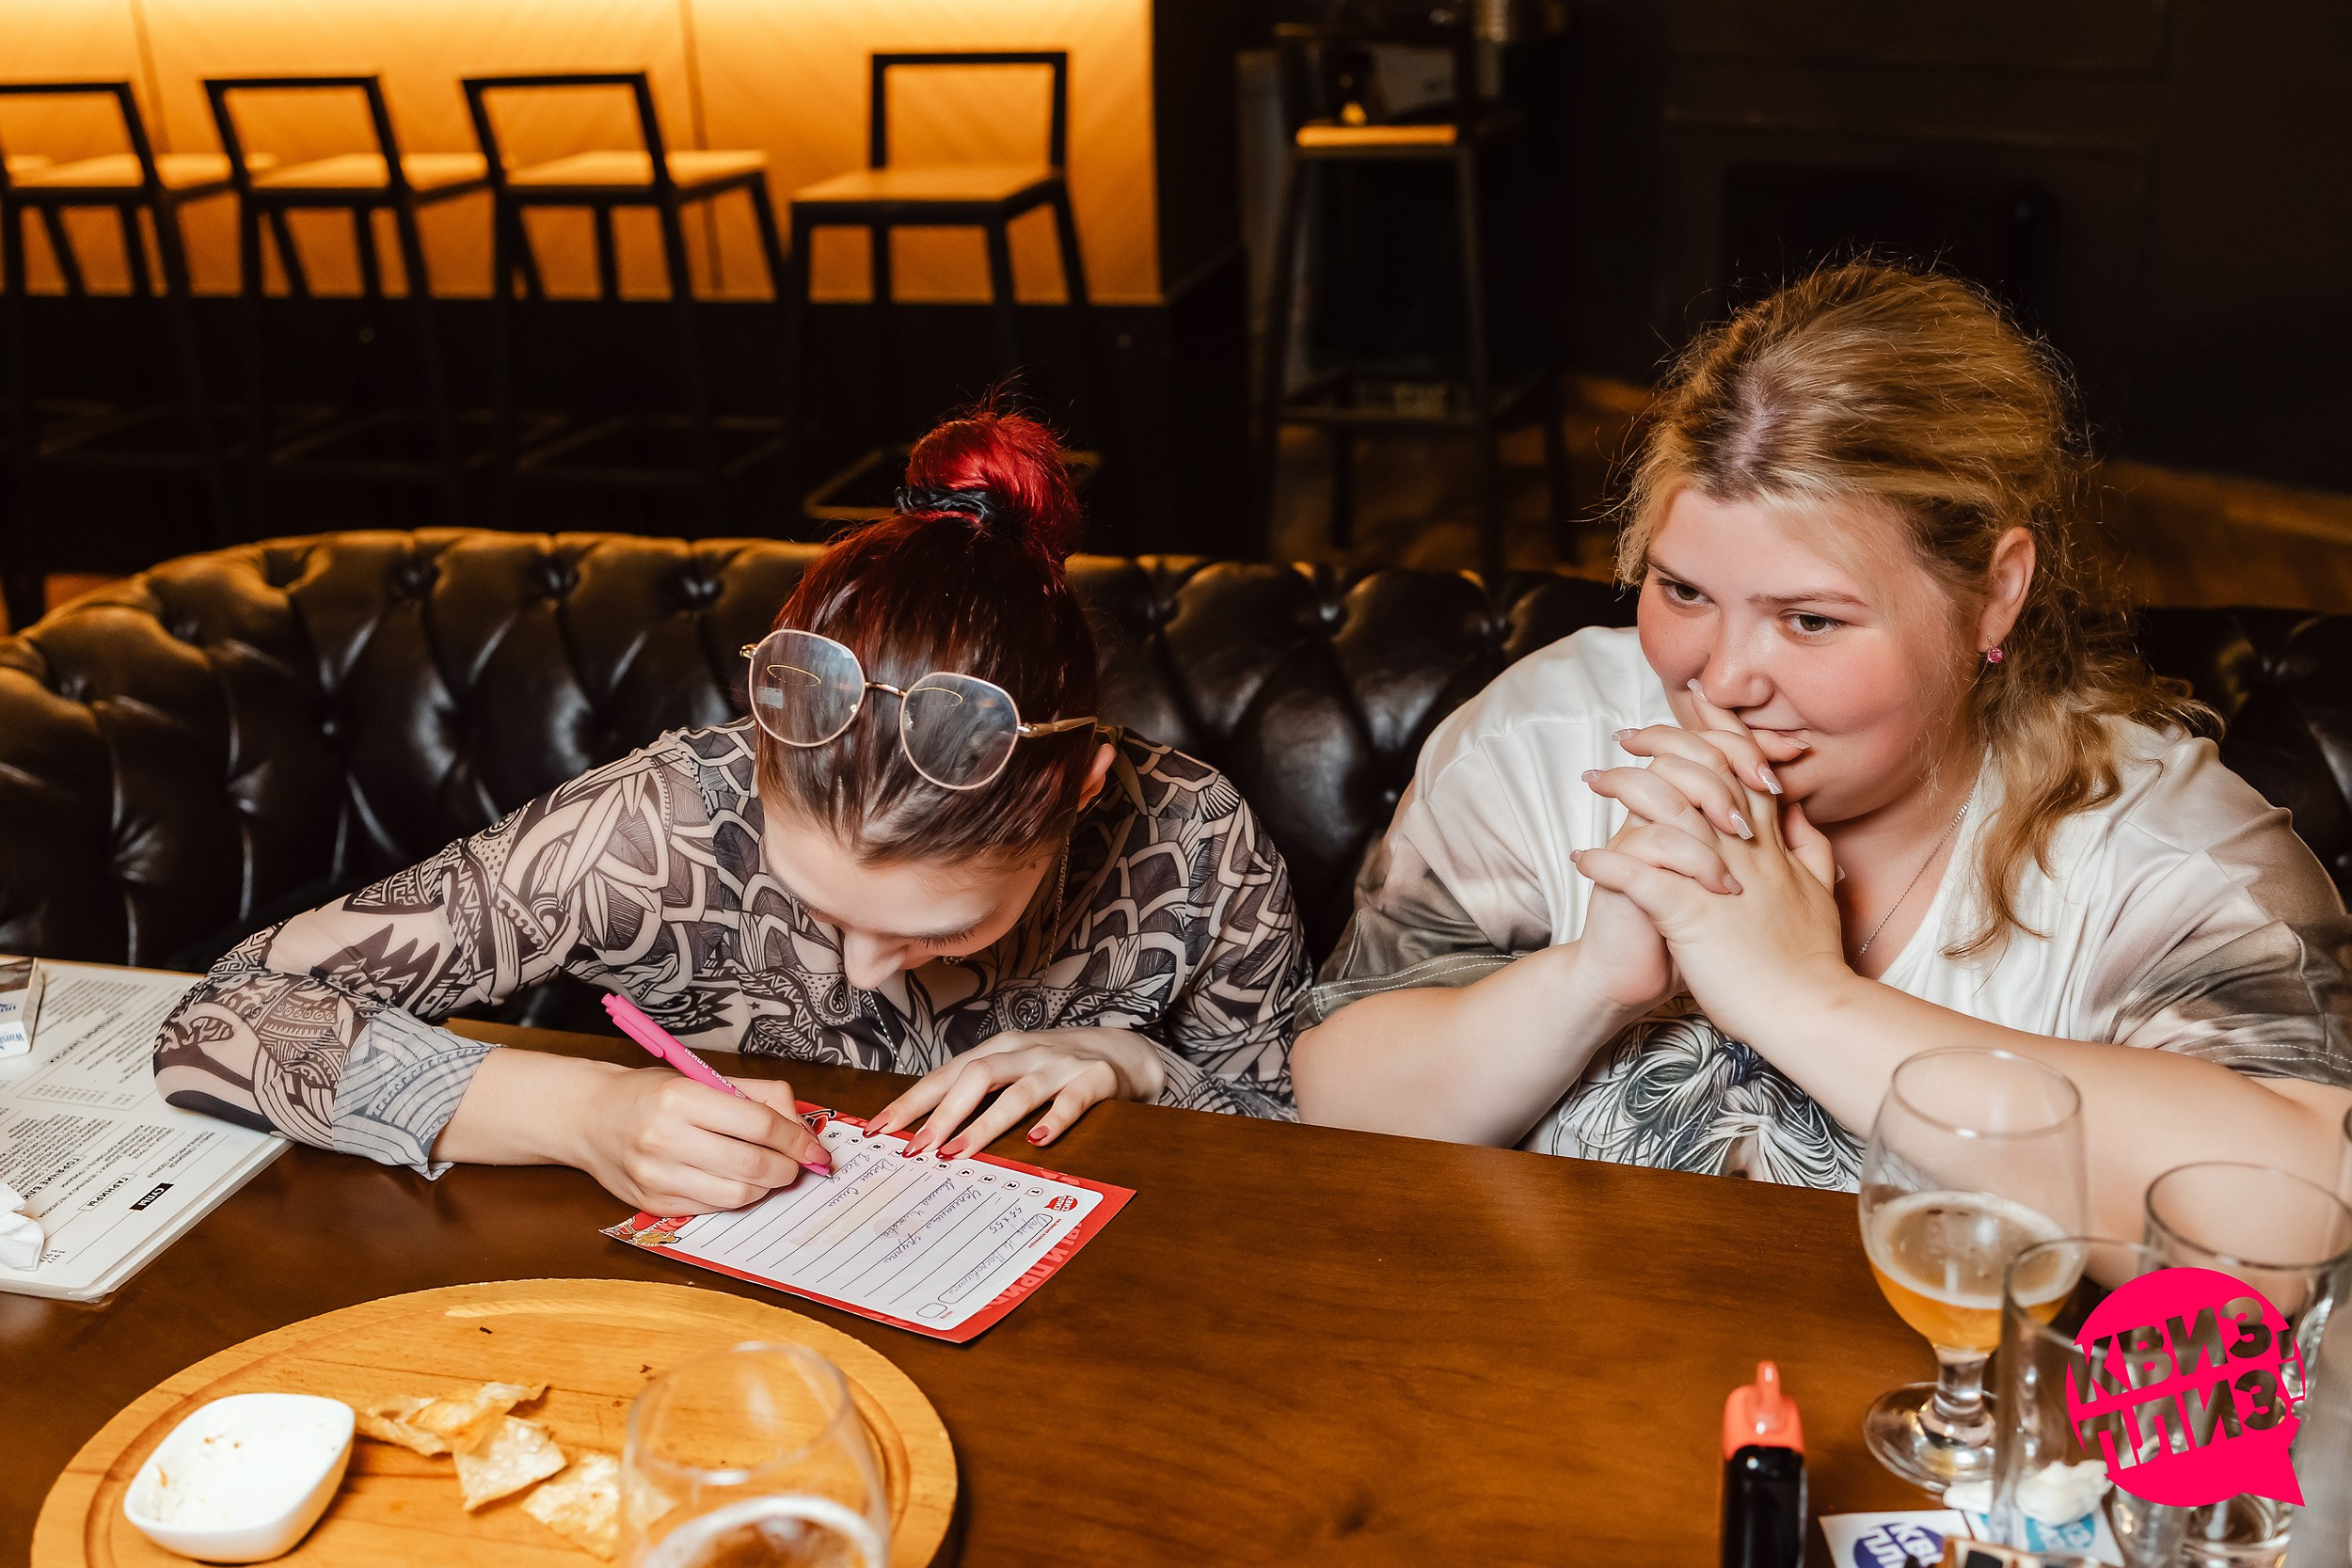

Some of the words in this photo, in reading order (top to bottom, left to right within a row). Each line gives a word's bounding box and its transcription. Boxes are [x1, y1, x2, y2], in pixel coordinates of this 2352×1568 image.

[42, 1157, 80, 1184] ГОРЯЧИЕ
[86, 1177, 129, 1207] ГАРНИРЫ
[136, 1187, 166, 1206] СУПЫ
